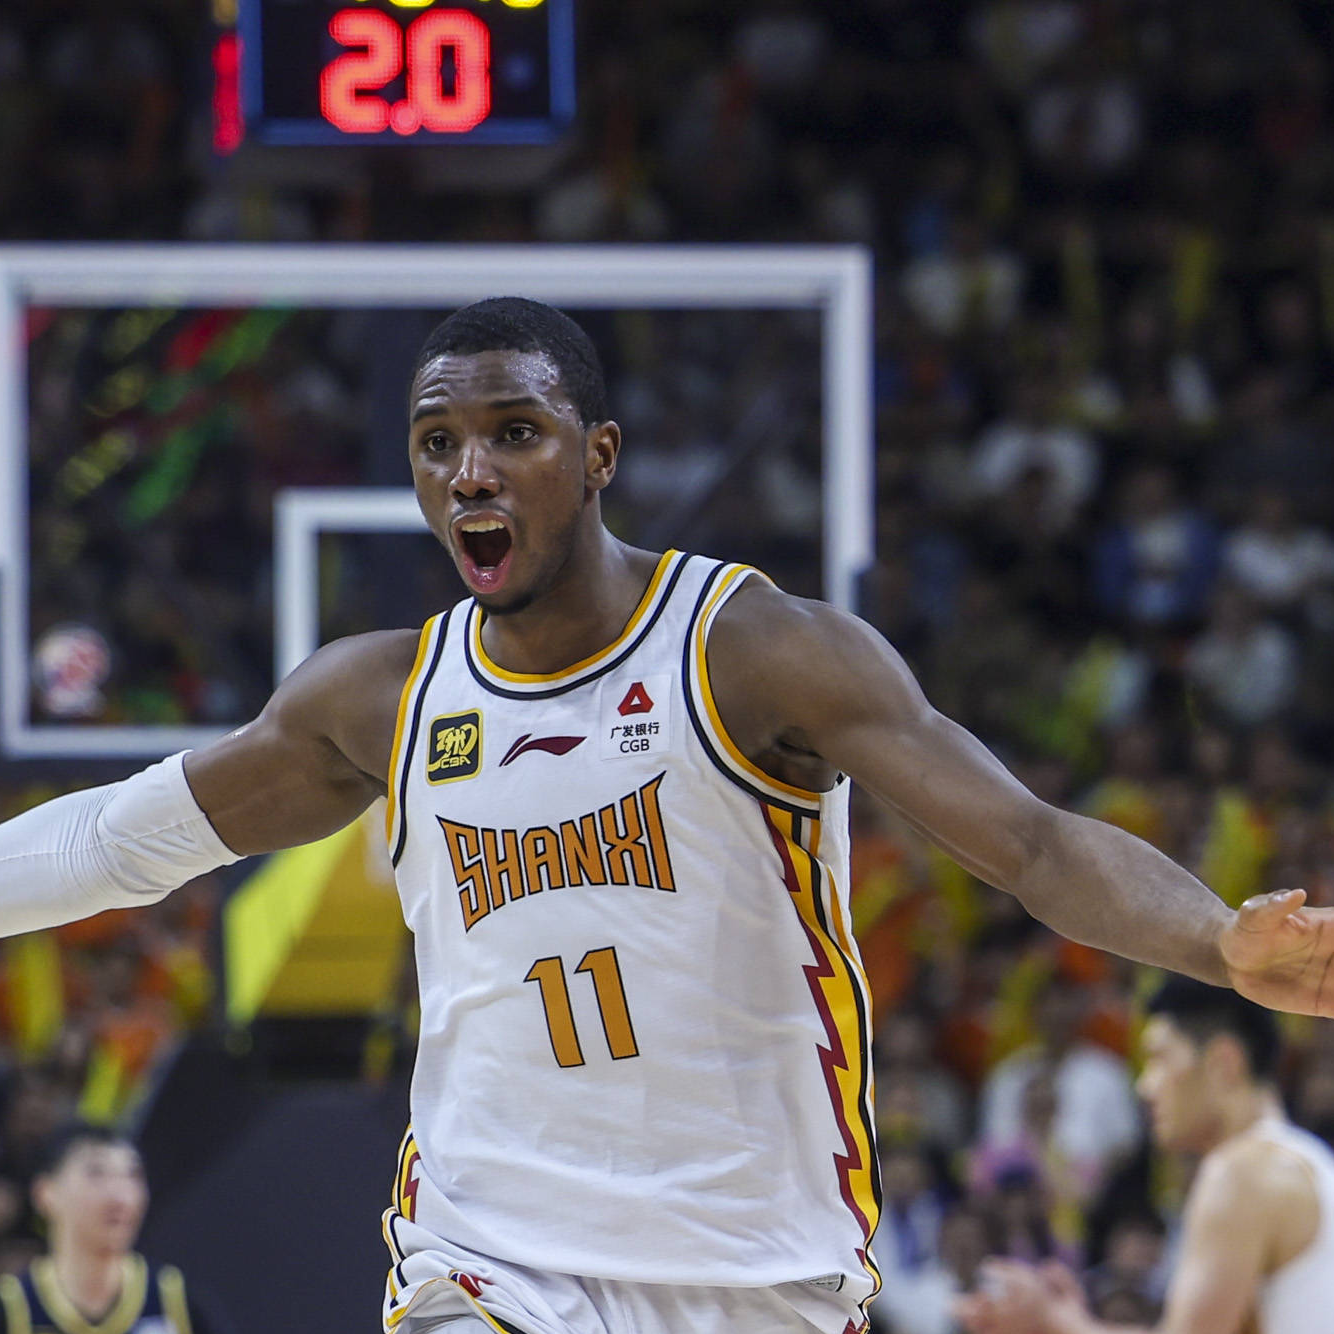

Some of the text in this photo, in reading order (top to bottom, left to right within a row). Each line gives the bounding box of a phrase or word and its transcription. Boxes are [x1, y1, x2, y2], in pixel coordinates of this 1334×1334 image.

[320, 7, 491, 135] 2.0
[441, 755, 471, 769] CBA
[610, 722, 660, 739] 广发银行
[619, 739, 650, 753] CGB
[435, 770, 677, 933] SHANXI
[523, 946, 640, 1068] 11
